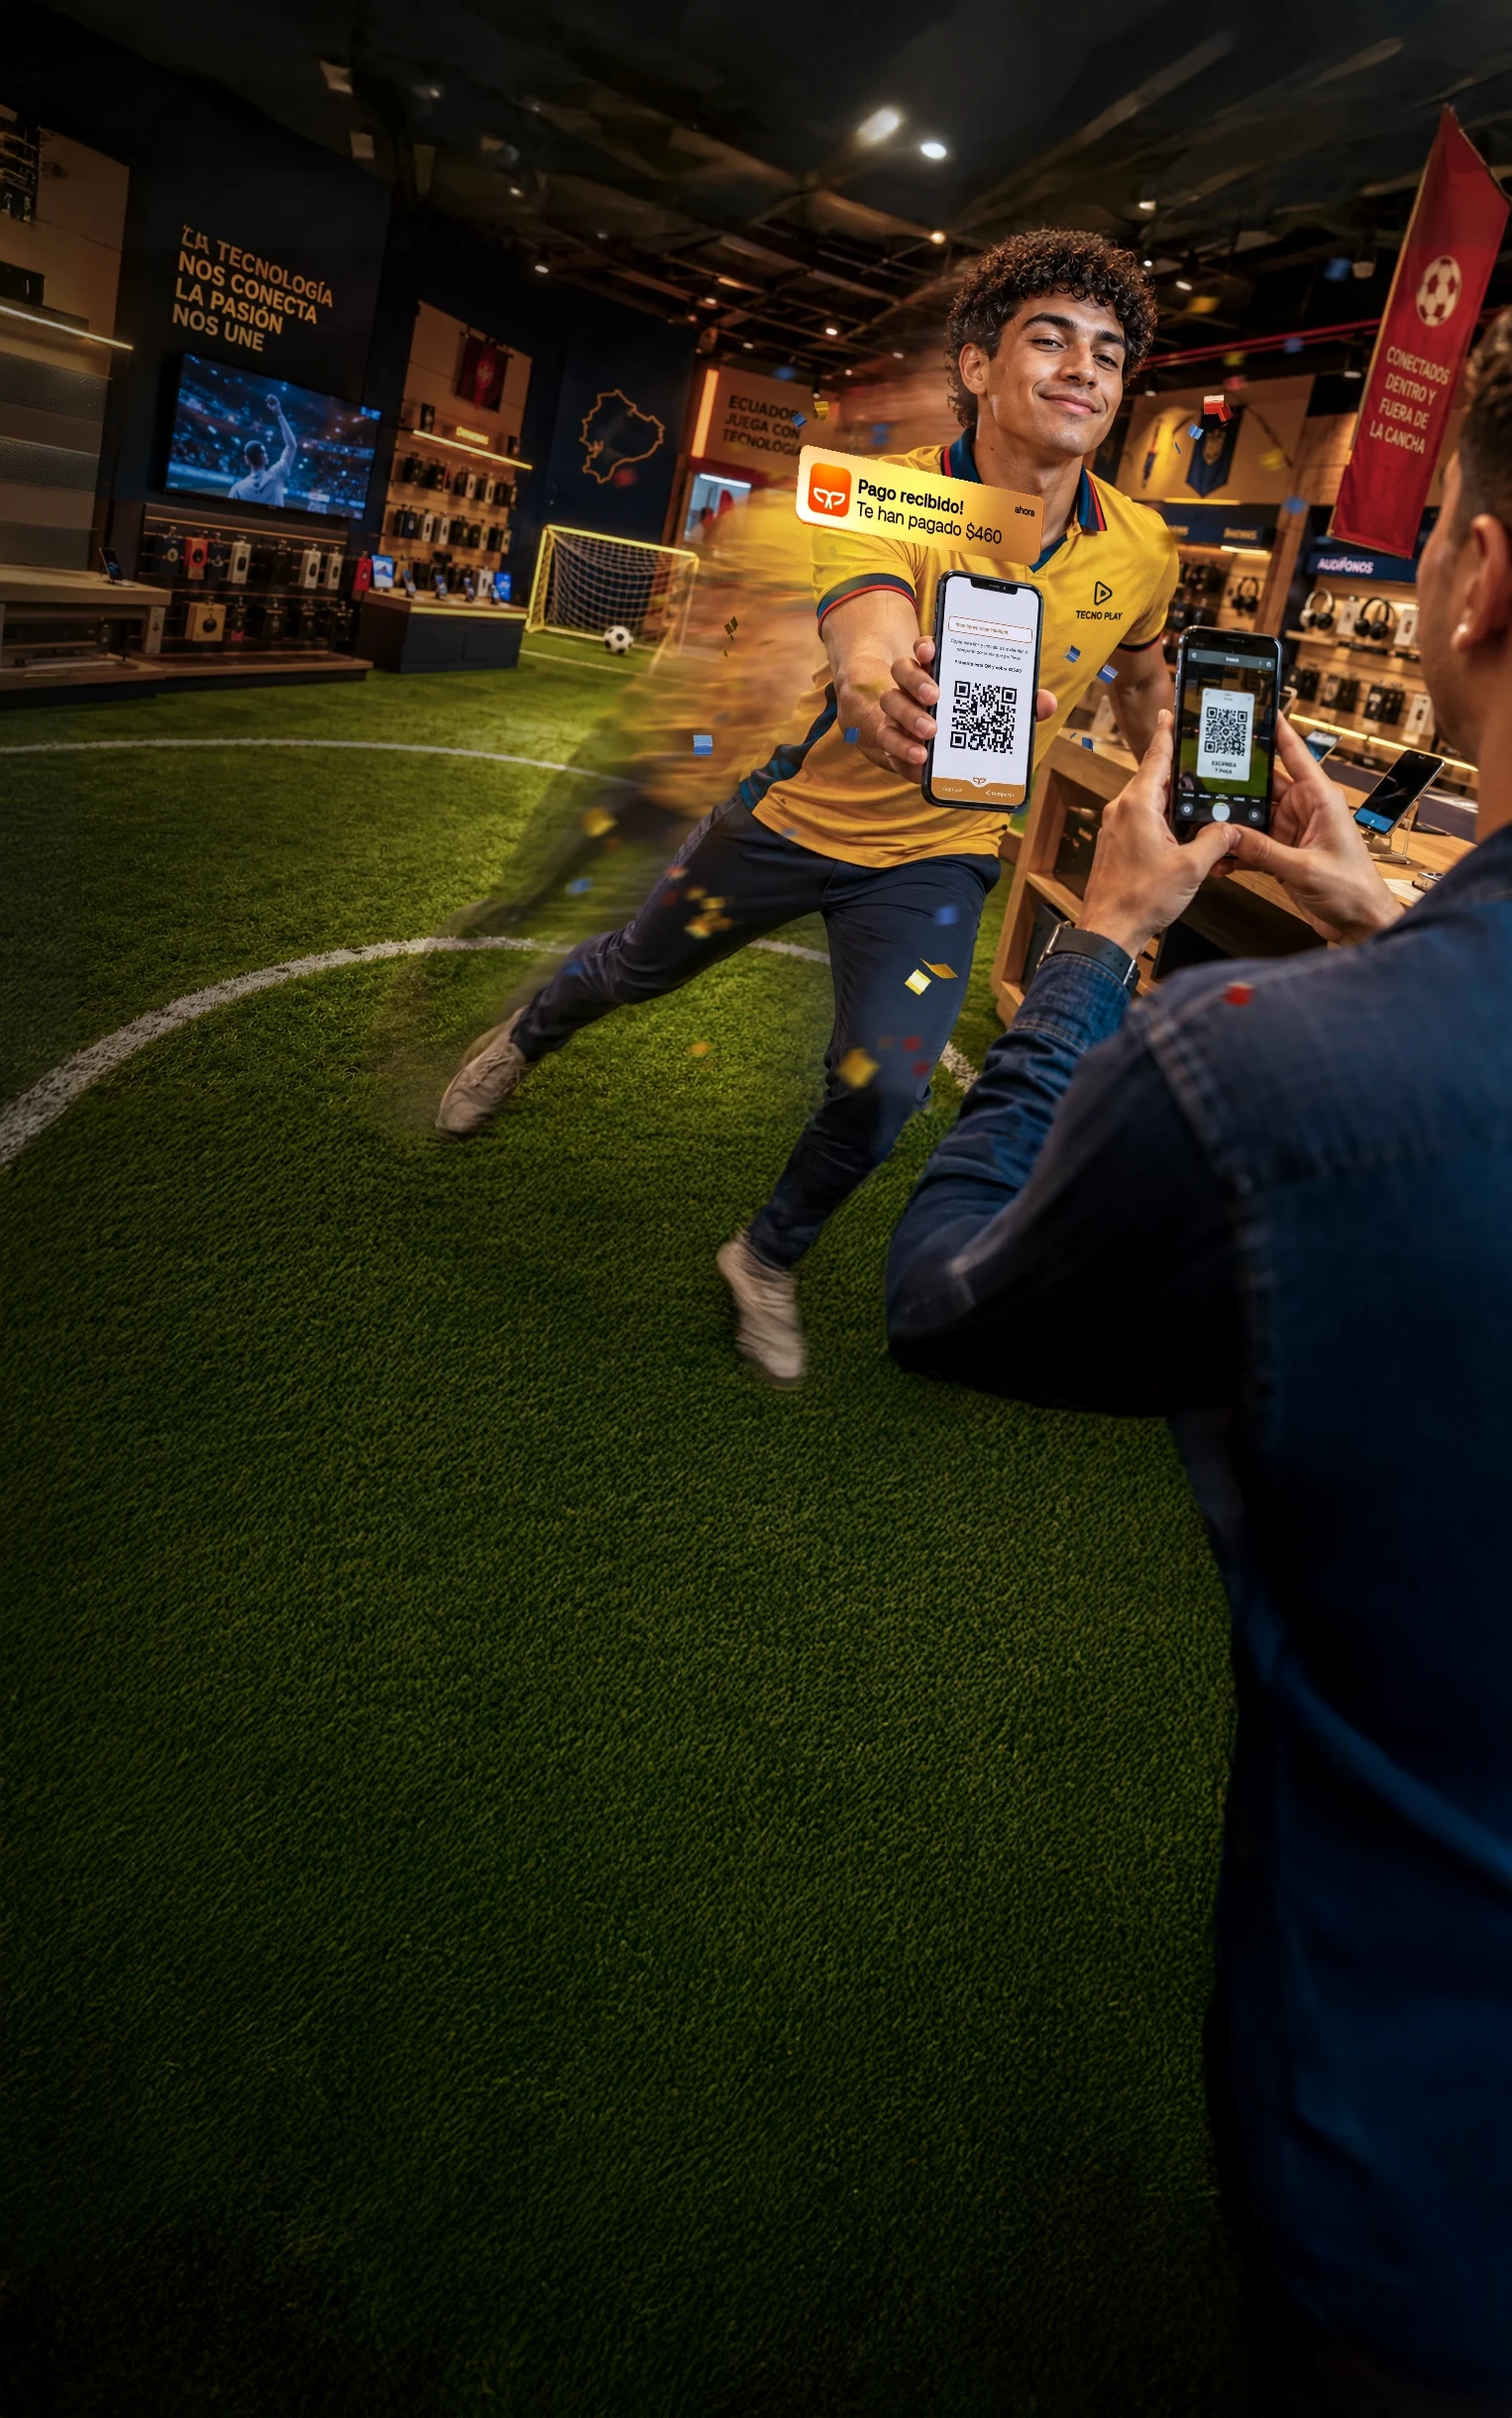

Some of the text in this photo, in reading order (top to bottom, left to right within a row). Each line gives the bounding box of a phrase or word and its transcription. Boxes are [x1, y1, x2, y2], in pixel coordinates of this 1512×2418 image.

[181, 225, 333, 308] LA TECNOLOGÍA
[178, 251, 317, 324] NOS CONECTA
[175, 277, 283, 335] LA PASIÓN
[172, 303, 265, 352] NOS UNE
[1386, 346, 1451, 385] CONECTADOS
[1385, 373, 1437, 406] DENTRO Y
[724, 413, 802, 439] JUEGA CON
[1378, 397, 1430, 429] FUERA DE
[1369, 420, 1426, 454] LA CANCHA
[1075, 609, 1124, 621] TECNO PLAY
